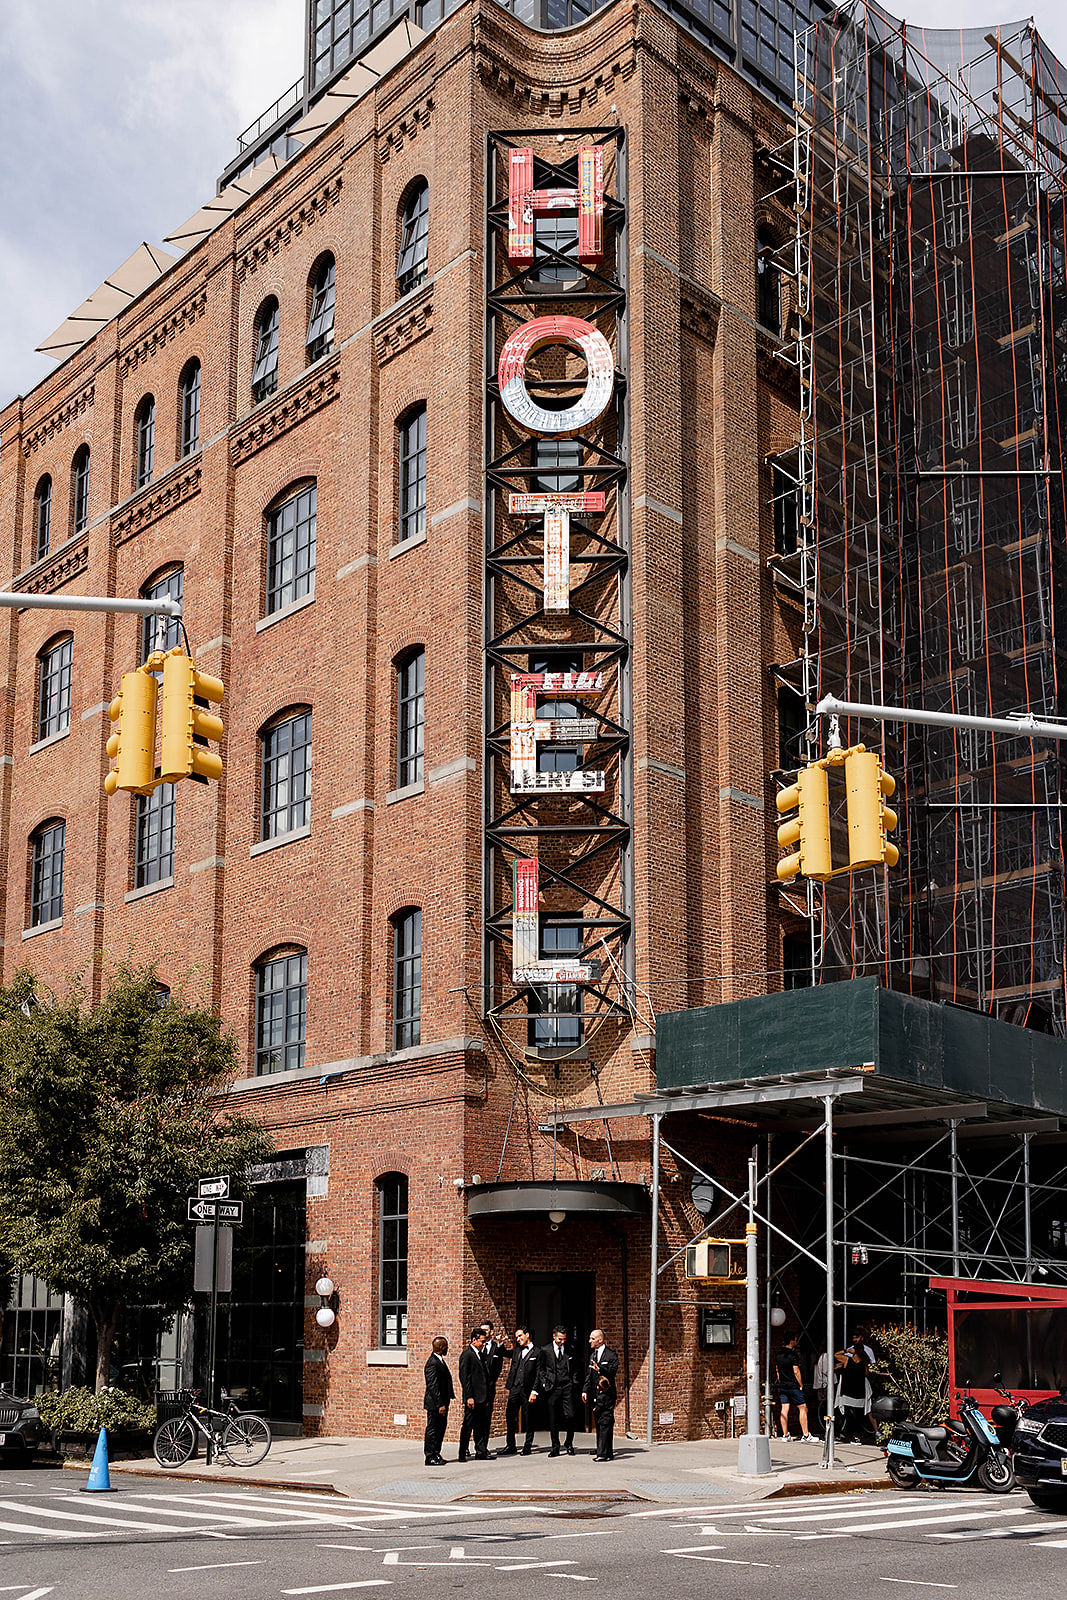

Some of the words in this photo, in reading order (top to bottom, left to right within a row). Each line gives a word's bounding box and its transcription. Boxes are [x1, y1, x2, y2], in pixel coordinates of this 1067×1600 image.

[498, 145, 614, 983] HOTEL
[202, 1185, 212, 1193] ONE
[197, 1205, 212, 1214] ONE
[218, 1206, 235, 1215] WAY
